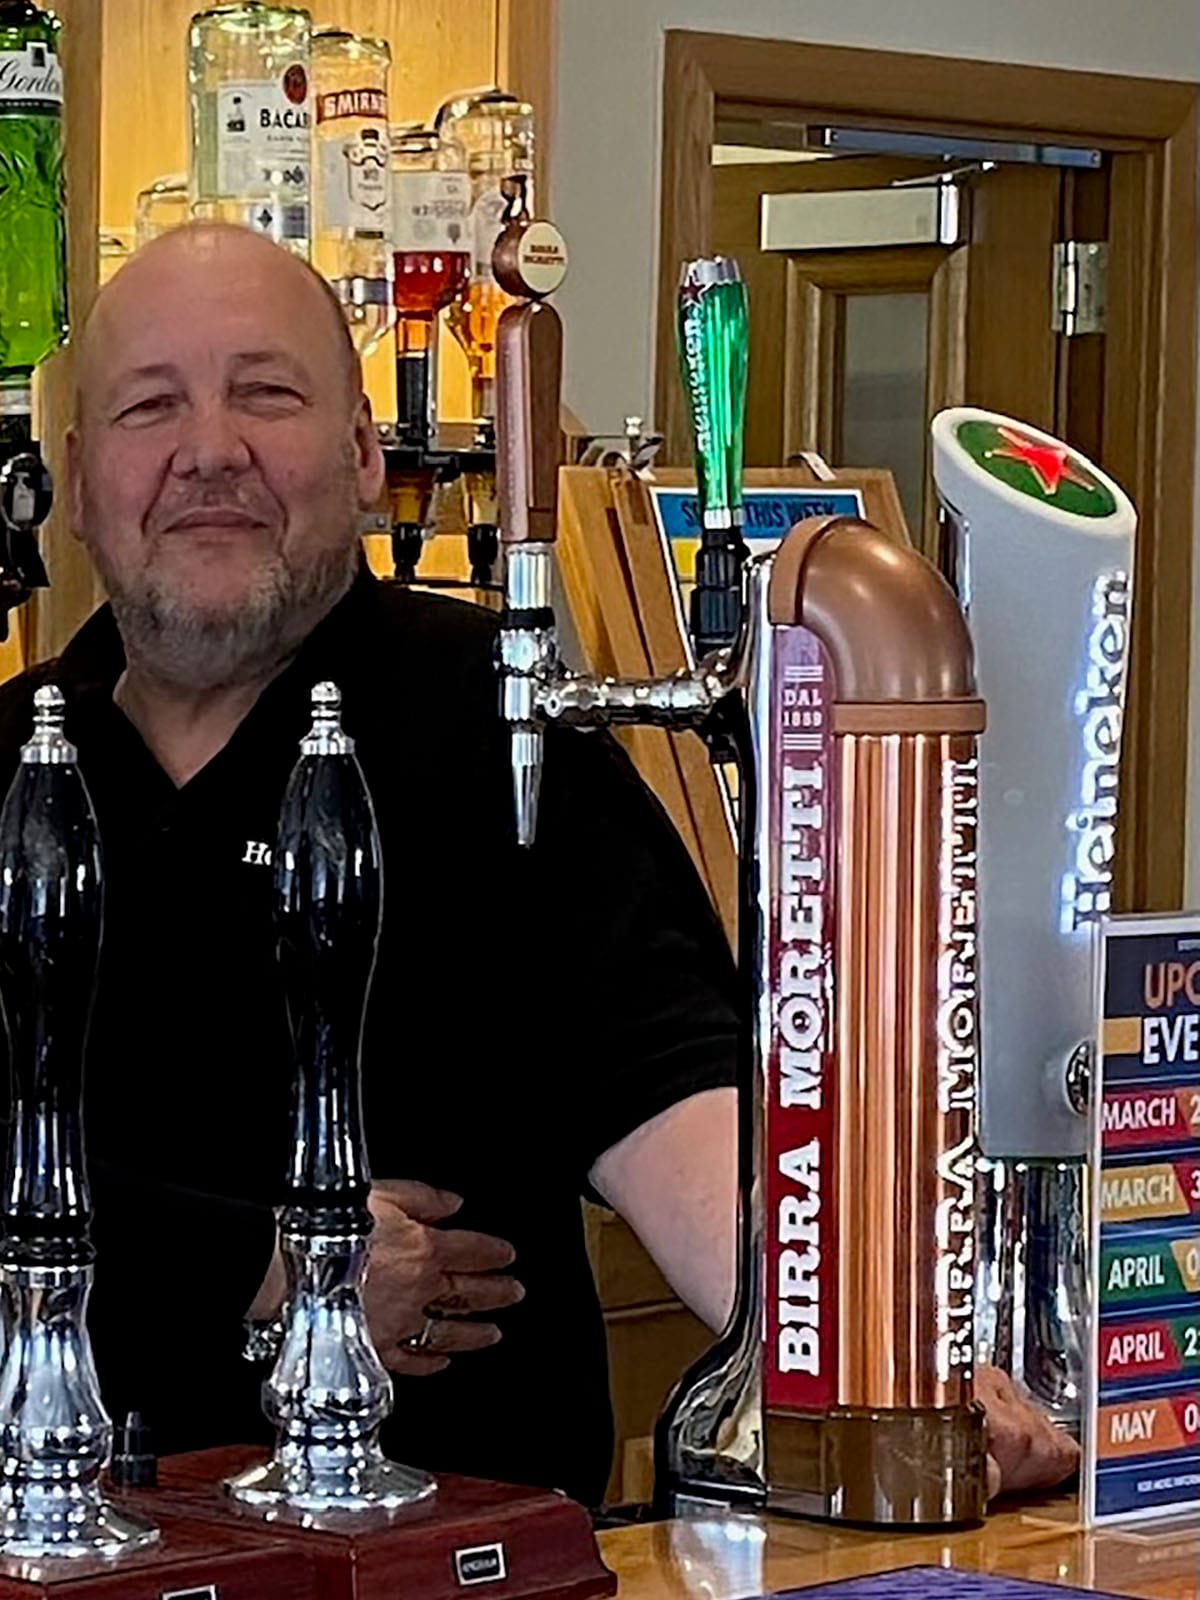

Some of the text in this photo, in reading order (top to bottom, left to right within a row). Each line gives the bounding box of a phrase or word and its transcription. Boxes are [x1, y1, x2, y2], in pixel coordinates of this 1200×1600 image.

[783, 689, 823, 706] DAL
[1058, 571, 1131, 935] Heineken
[1143, 1013, 1200, 1065] EVE
[778, 763, 823, 1377] BIRRA MORETTI
[1100, 1094, 1200, 1132] MARCH 2
[1100, 1173, 1175, 1210] MARCH
[1107, 1247, 1200, 1291] APRIL 0
[1106, 1326, 1200, 1367] APRIL 2
[1110, 1402, 1199, 1444] MAY 0
